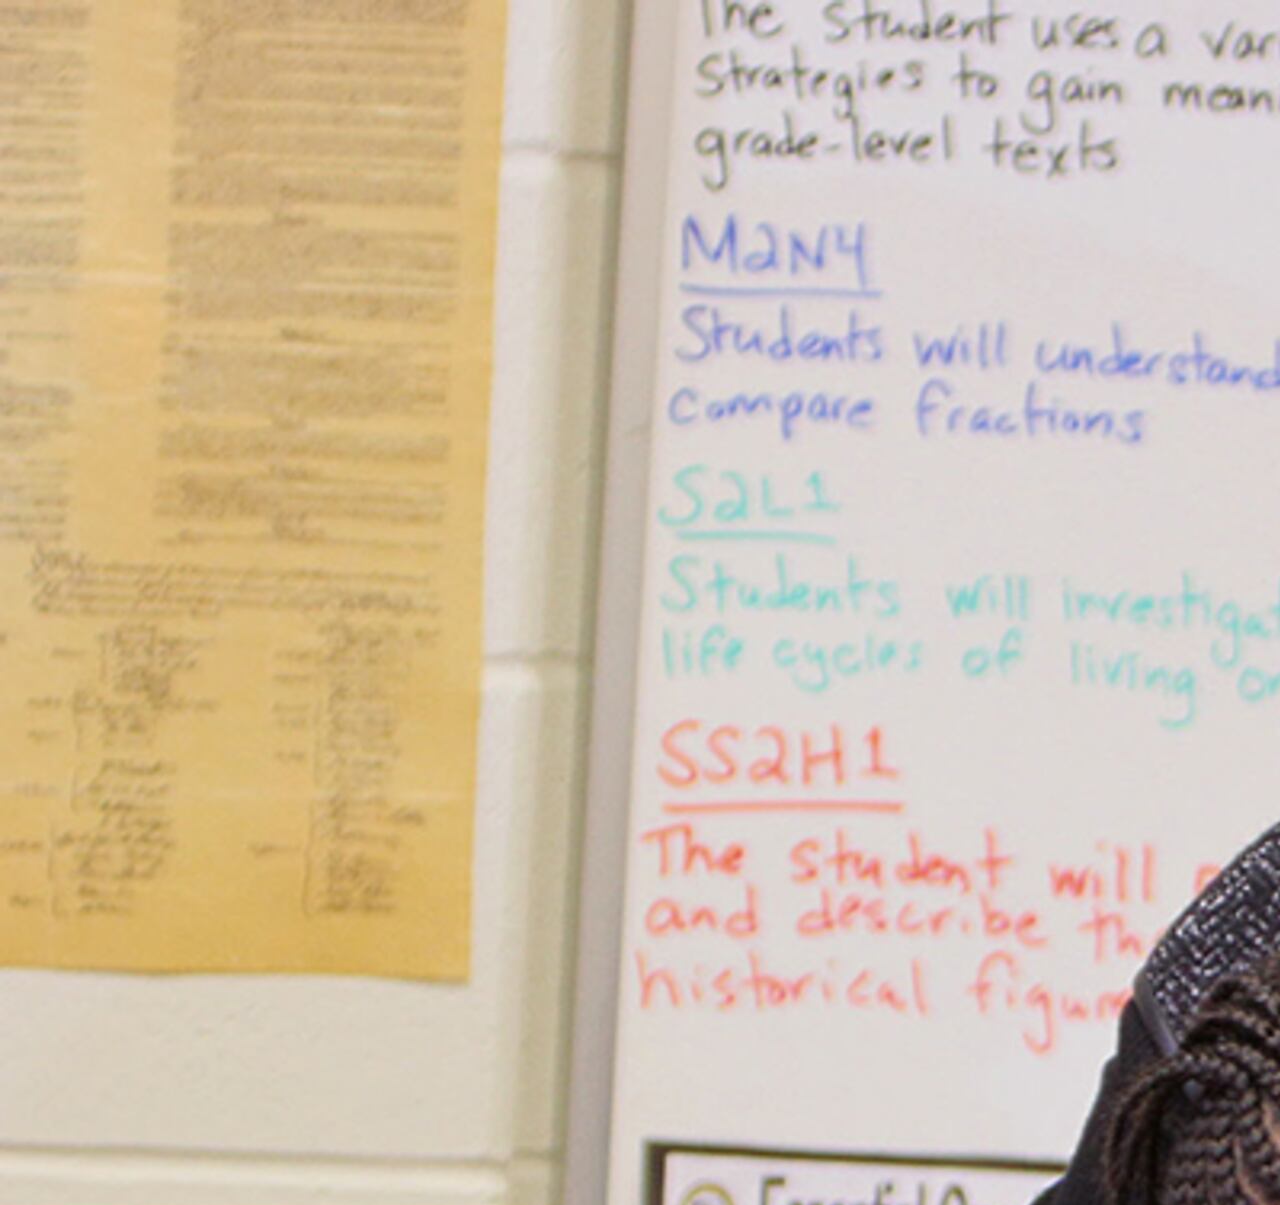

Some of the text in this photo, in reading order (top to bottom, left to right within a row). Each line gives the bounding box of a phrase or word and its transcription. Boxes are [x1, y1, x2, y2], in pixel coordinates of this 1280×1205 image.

[1133, 22, 1168, 62] a
[952, 52, 998, 100] to
[1018, 66, 1124, 136] gain
[694, 108, 1118, 192] grade-level texts
[674, 304, 884, 364] Students
[913, 321, 1008, 370] will
[915, 378, 1146, 444] fractions
[662, 554, 902, 616] Students
[945, 576, 1032, 620] will
[662, 632, 744, 678] life
[772, 636, 924, 692] cycles
[962, 634, 1024, 678] of
[1070, 642, 1198, 728] living
[656, 719, 904, 788] SS2H1
[641, 822, 748, 880] The
[789, 826, 1014, 892] student
[1048, 838, 1156, 904] will
[644, 888, 1165, 962] and describe th
[634, 950, 932, 1018] historical
